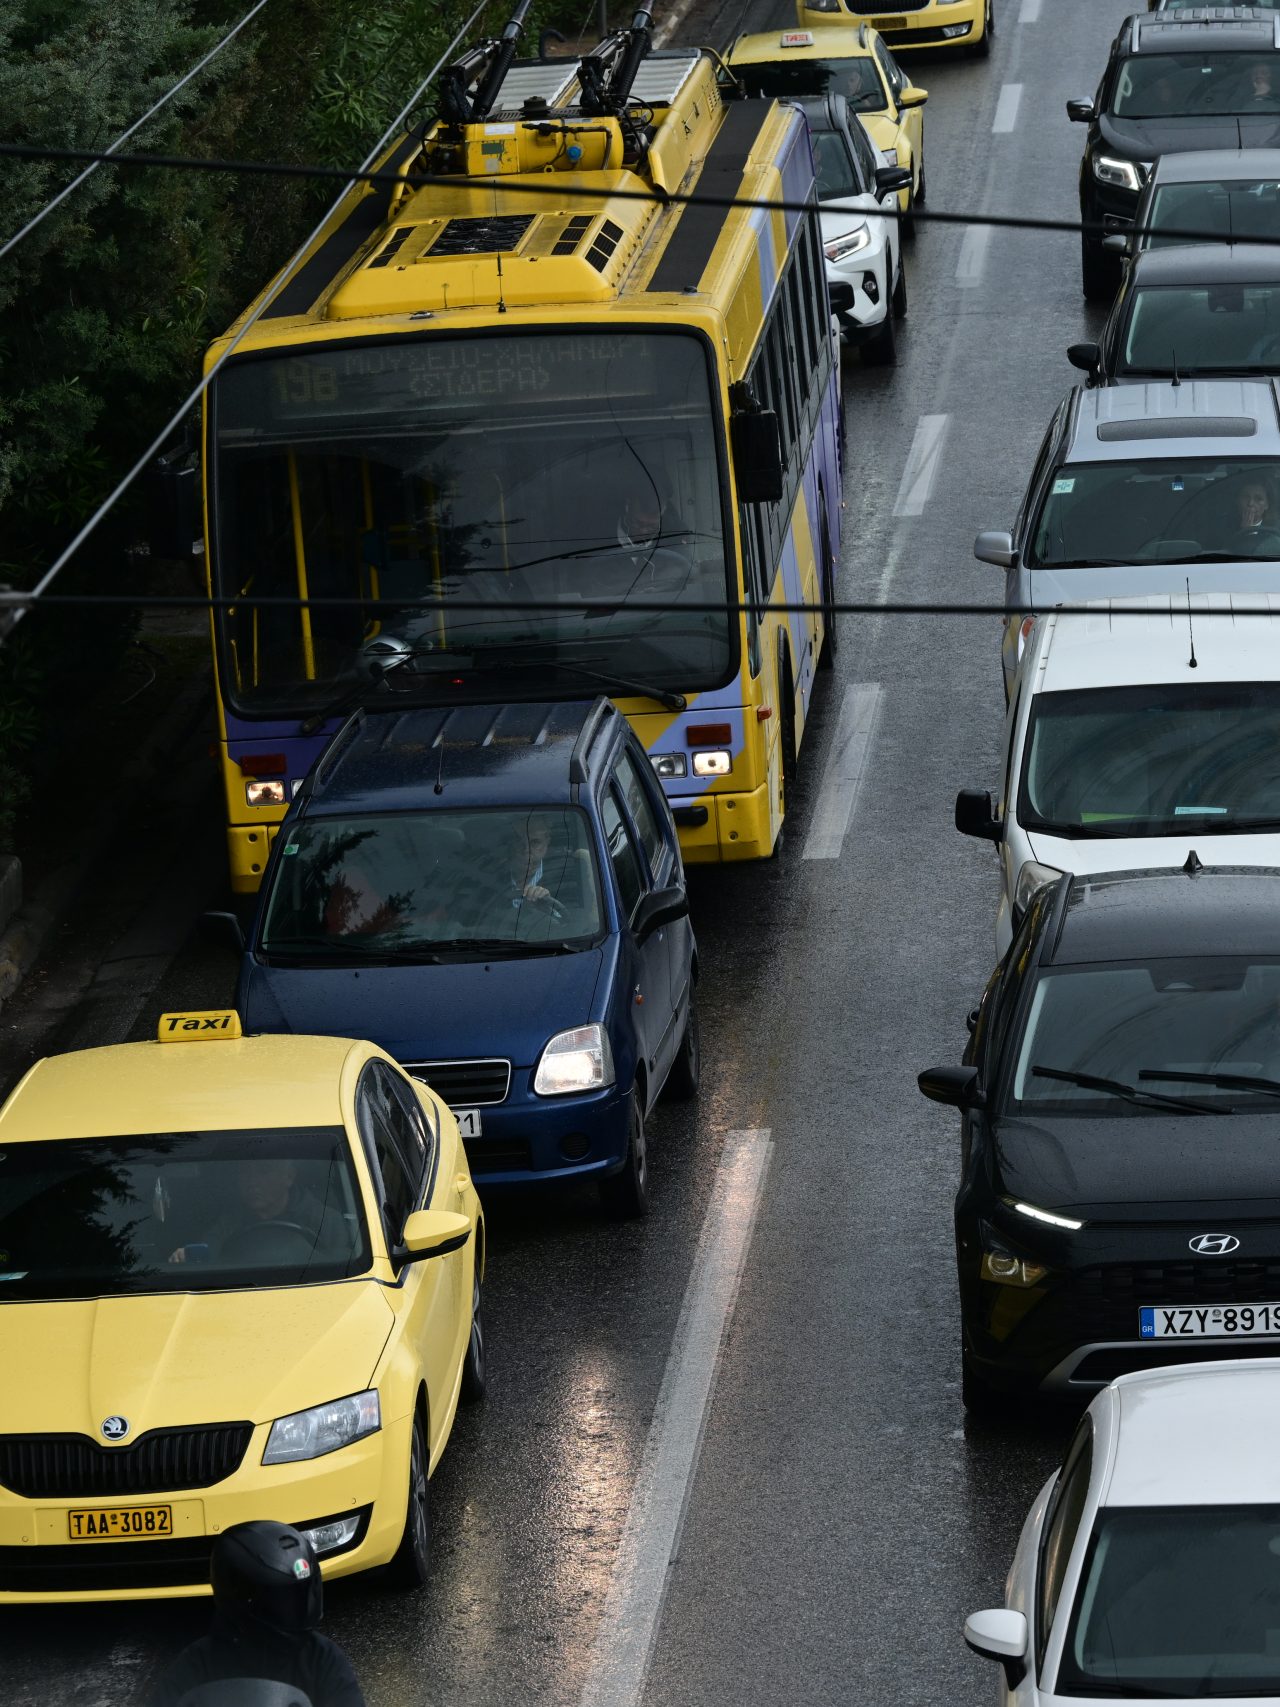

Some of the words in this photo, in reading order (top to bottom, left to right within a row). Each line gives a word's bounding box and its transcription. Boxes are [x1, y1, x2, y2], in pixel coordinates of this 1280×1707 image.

[166, 1015, 231, 1031] Taxi
[1142, 1325, 1153, 1333] GR
[72, 1510, 168, 1535] TAA-3082
